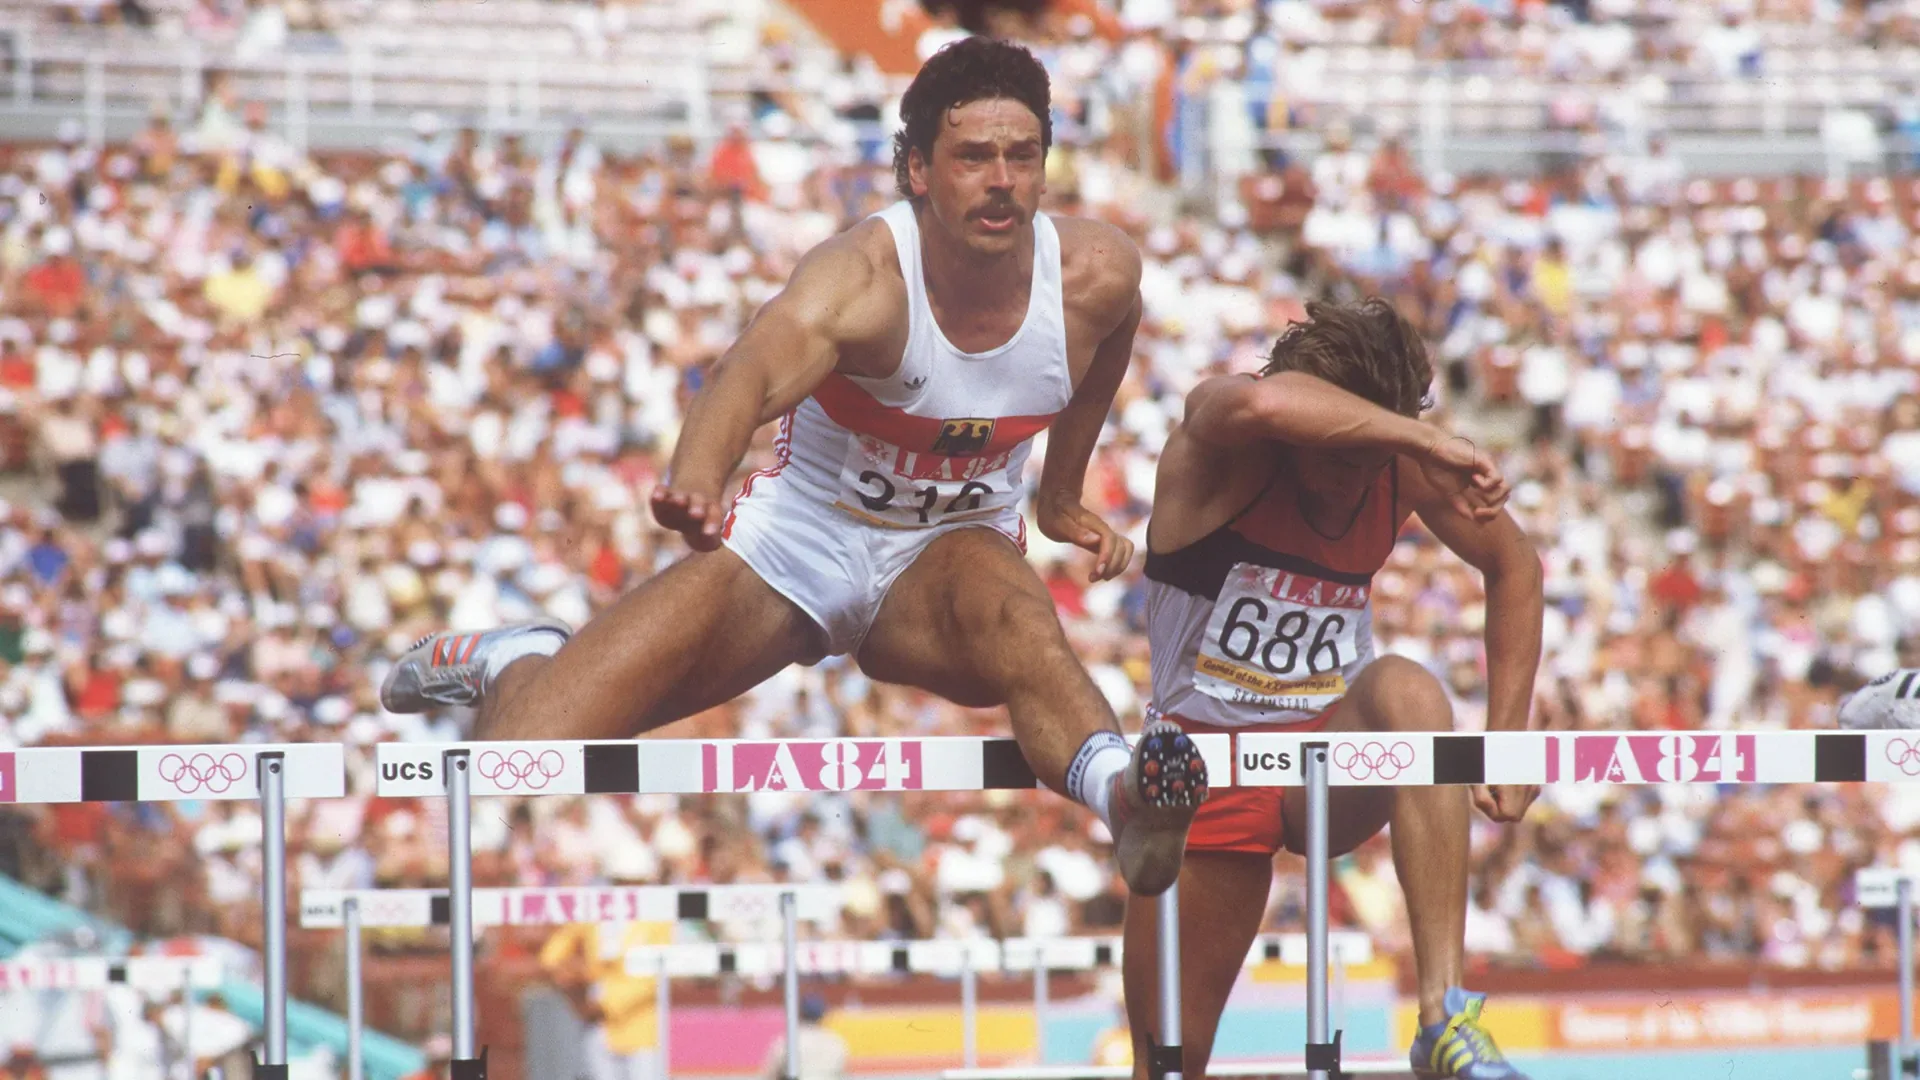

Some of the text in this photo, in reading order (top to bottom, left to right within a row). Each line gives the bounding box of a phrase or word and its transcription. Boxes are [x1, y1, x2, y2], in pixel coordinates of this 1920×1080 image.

[1218, 596, 1345, 676] 686
[1236, 671, 1248, 681] of
[1248, 675, 1264, 688] the
[382, 761, 433, 781] UCS
[712, 741, 911, 793] LA84
[1243, 752, 1291, 771] UCS
[1554, 735, 1745, 785] LA84
